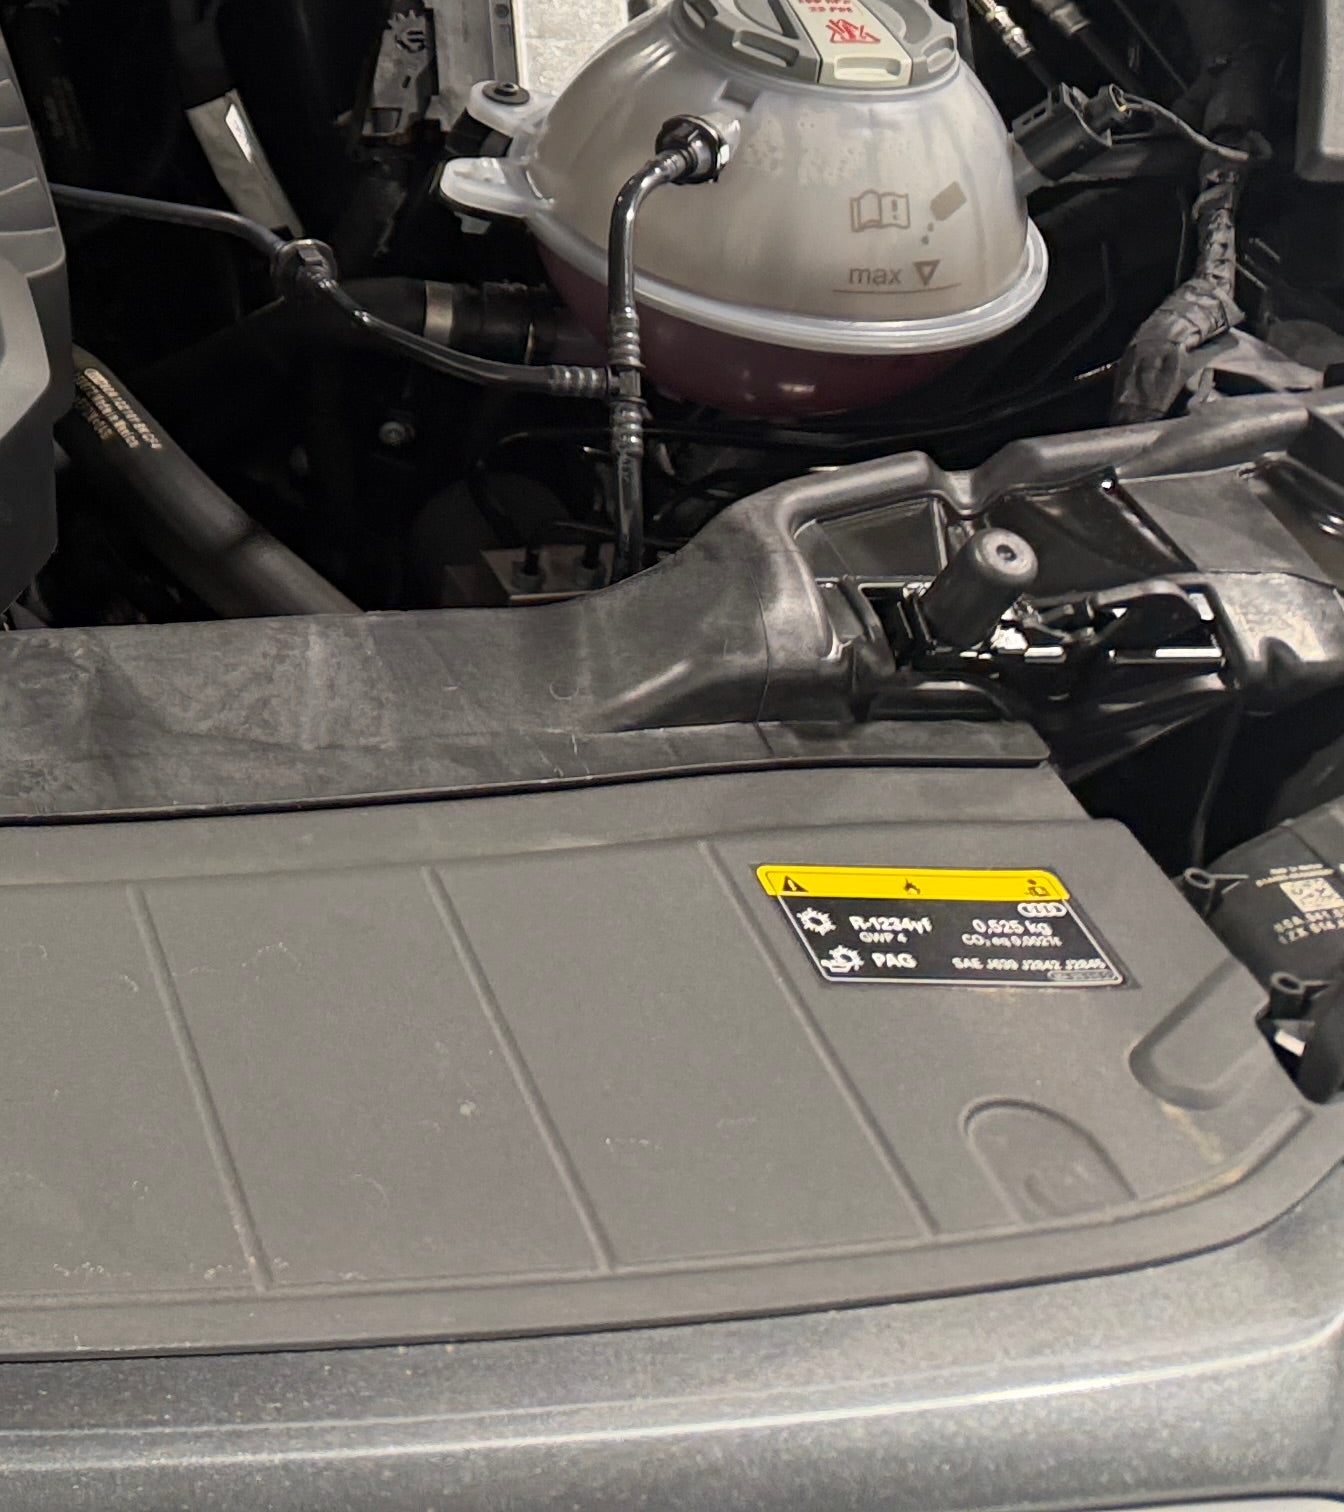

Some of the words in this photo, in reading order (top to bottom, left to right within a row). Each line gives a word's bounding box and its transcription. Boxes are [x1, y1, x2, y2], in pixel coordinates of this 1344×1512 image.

[849, 268, 902, 286] max
[849, 916, 932, 934] R-1234yf
[972, 919, 1025, 934] 0,525
[1024, 920, 1054, 935] kg
[859, 931, 894, 943] GWP
[872, 952, 918, 968] PAG
[952, 957, 984, 969] SAE
